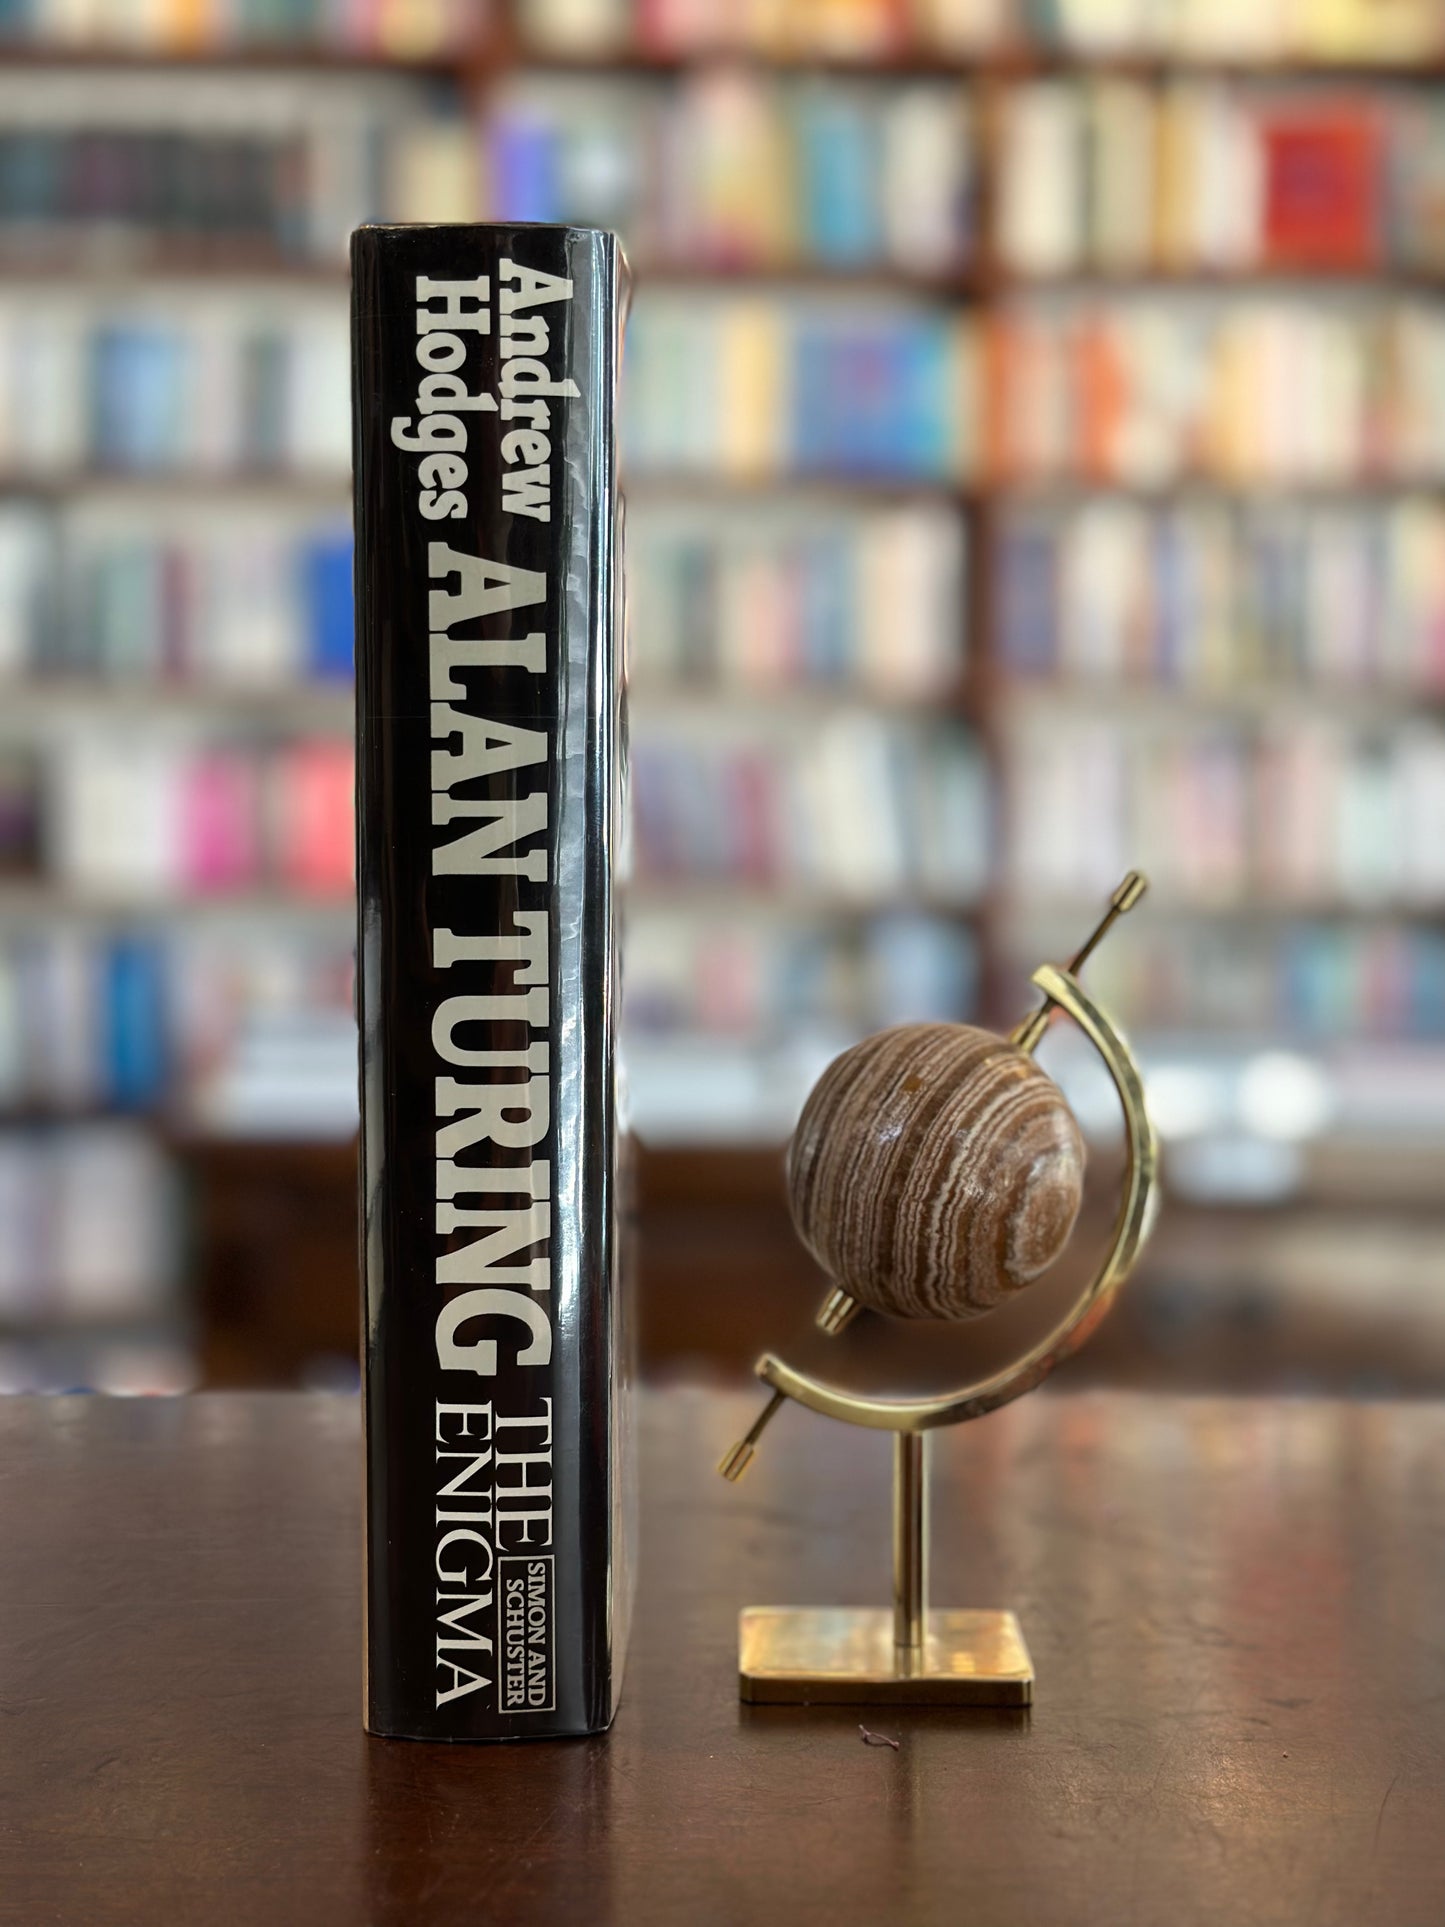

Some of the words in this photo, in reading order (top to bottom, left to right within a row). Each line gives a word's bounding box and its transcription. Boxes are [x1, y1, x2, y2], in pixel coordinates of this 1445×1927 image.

[391, 275, 499, 520] Hodges
[498, 258, 581, 522] Andrew
[428, 542, 548, 883] ALAN
[431, 911, 551, 1376] TURING
[435, 1397, 493, 1711] ENIGMA
[495, 1397, 552, 1551] THE
[506, 1578, 525, 1707] SCHUSTER
[527, 1562, 546, 1644] SIMON
[527, 1649, 546, 1707] AND
